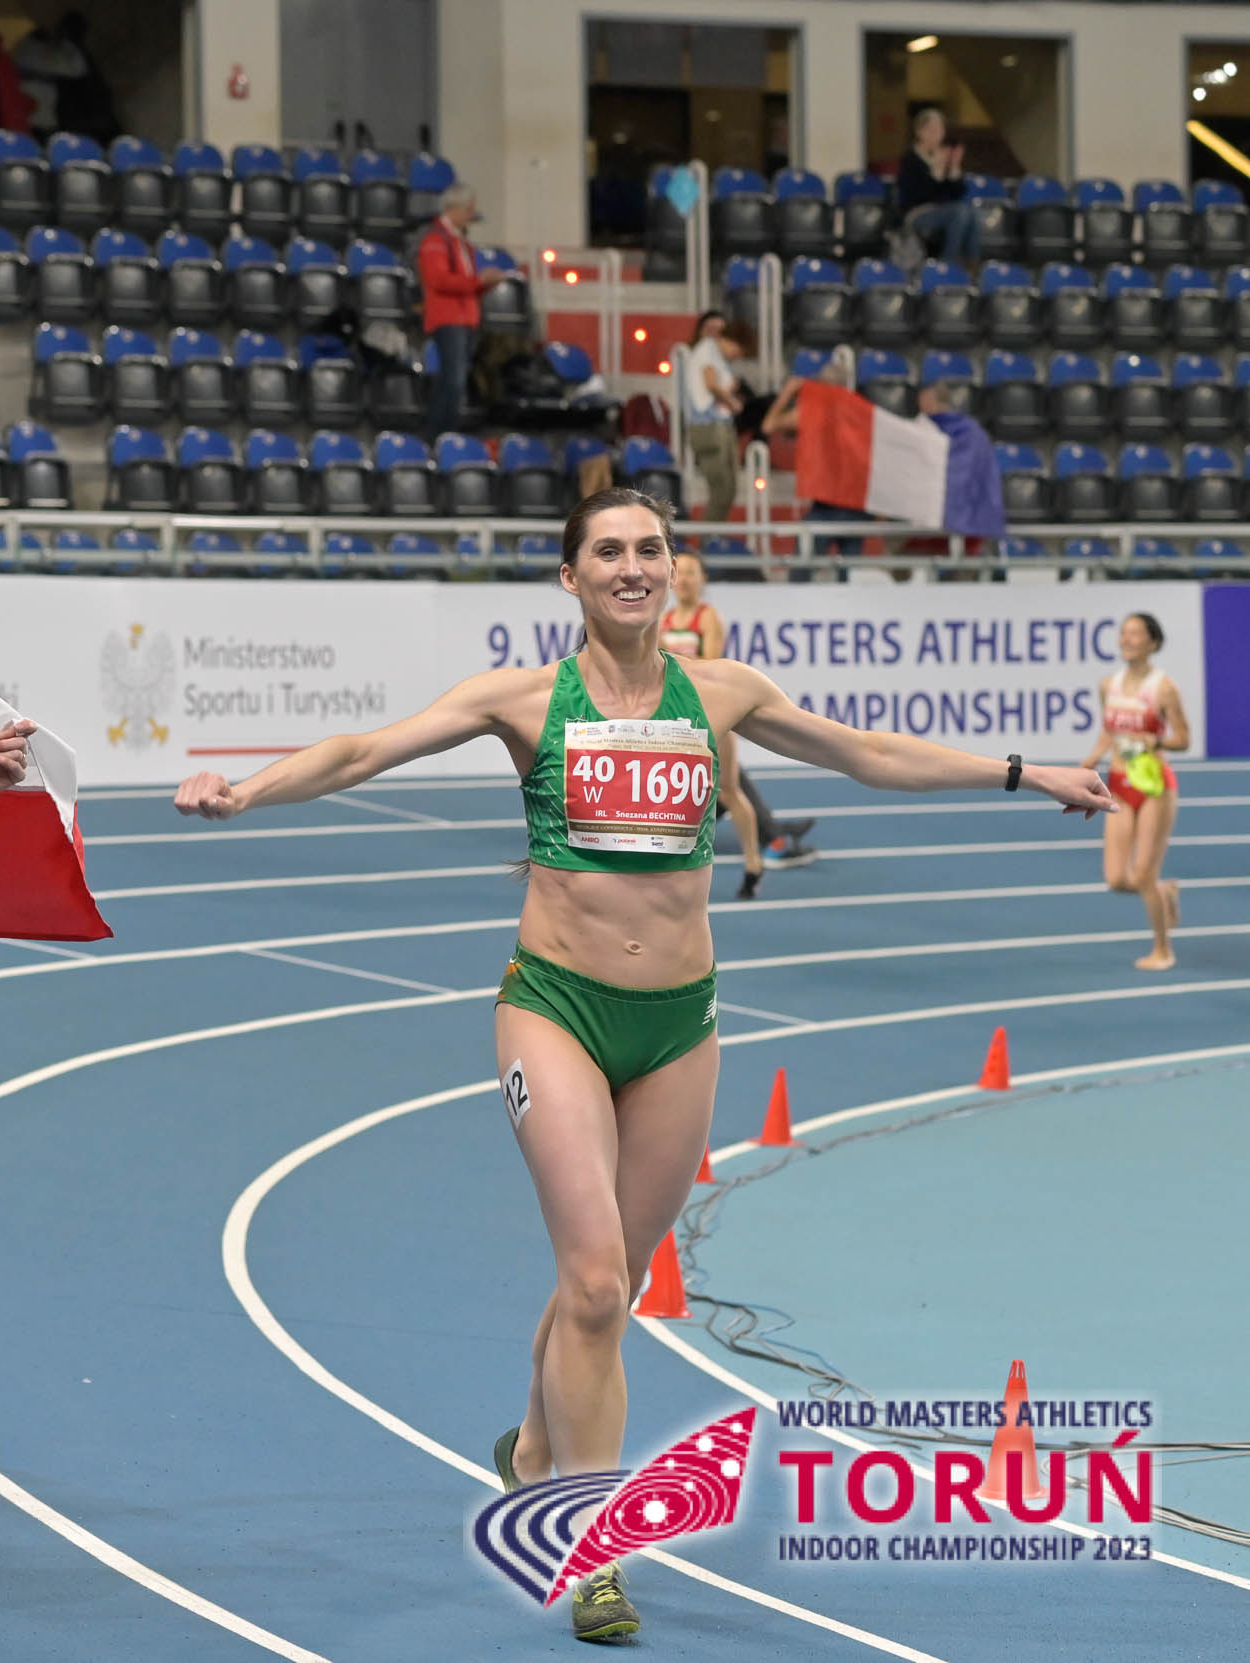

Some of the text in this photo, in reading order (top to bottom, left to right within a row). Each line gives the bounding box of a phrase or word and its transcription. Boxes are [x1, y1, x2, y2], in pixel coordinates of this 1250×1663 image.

[184, 636, 336, 669] Ministerstwo
[916, 619, 1116, 665] ATHLETIC
[184, 682, 386, 720] Sportu i Turystyki
[797, 690, 1094, 736] MPIONSHIPS
[572, 755, 708, 807] 40 1690
[583, 786, 603, 804] W
[595, 810, 686, 821] IRL Snezana BECHTINA
[504, 1070, 528, 1117] 12
